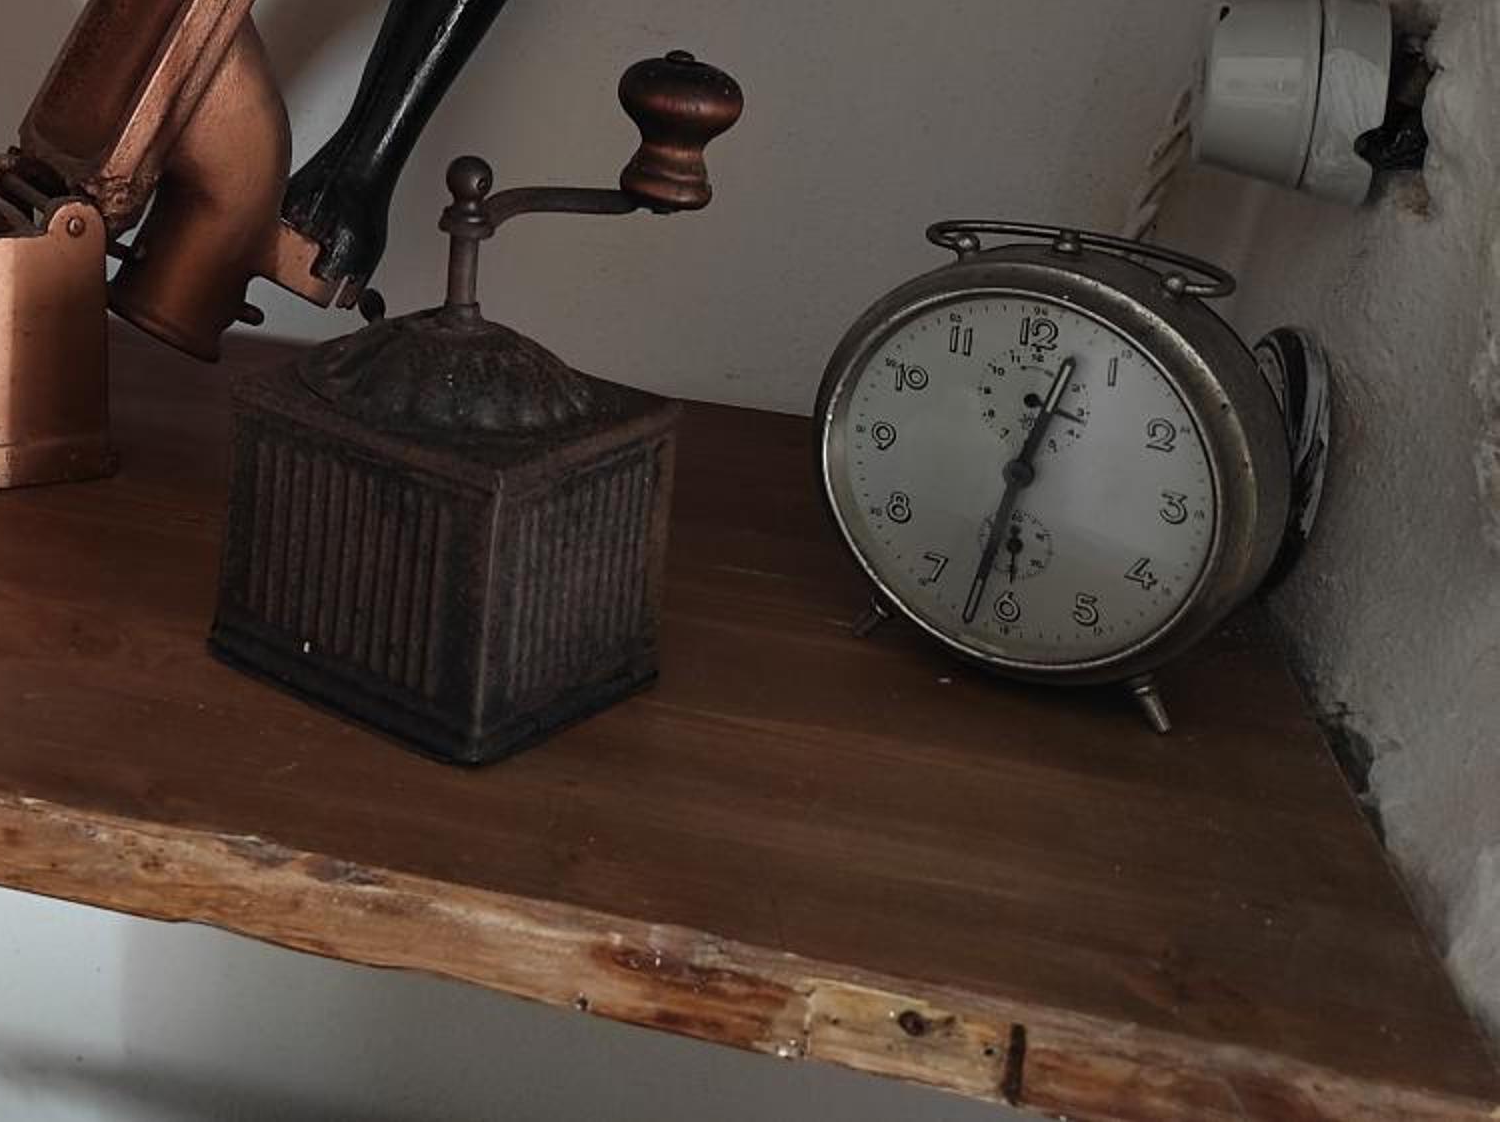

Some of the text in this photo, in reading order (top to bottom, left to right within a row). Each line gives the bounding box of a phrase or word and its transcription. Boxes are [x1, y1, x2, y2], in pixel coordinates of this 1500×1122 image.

[949, 325, 974, 356] 11
[1019, 317, 1060, 353] 12
[895, 363, 929, 392] 10
[1107, 357, 1119, 388] 1
[871, 421, 897, 451] 9
[1145, 418, 1177, 453] 2
[886, 491, 912, 524] 8
[1160, 491, 1189, 526] 3
[923, 552, 949, 583] 7
[1123, 557, 1157, 591] 4
[994, 591, 1021, 623] 6
[1072, 592, 1099, 627] 5
